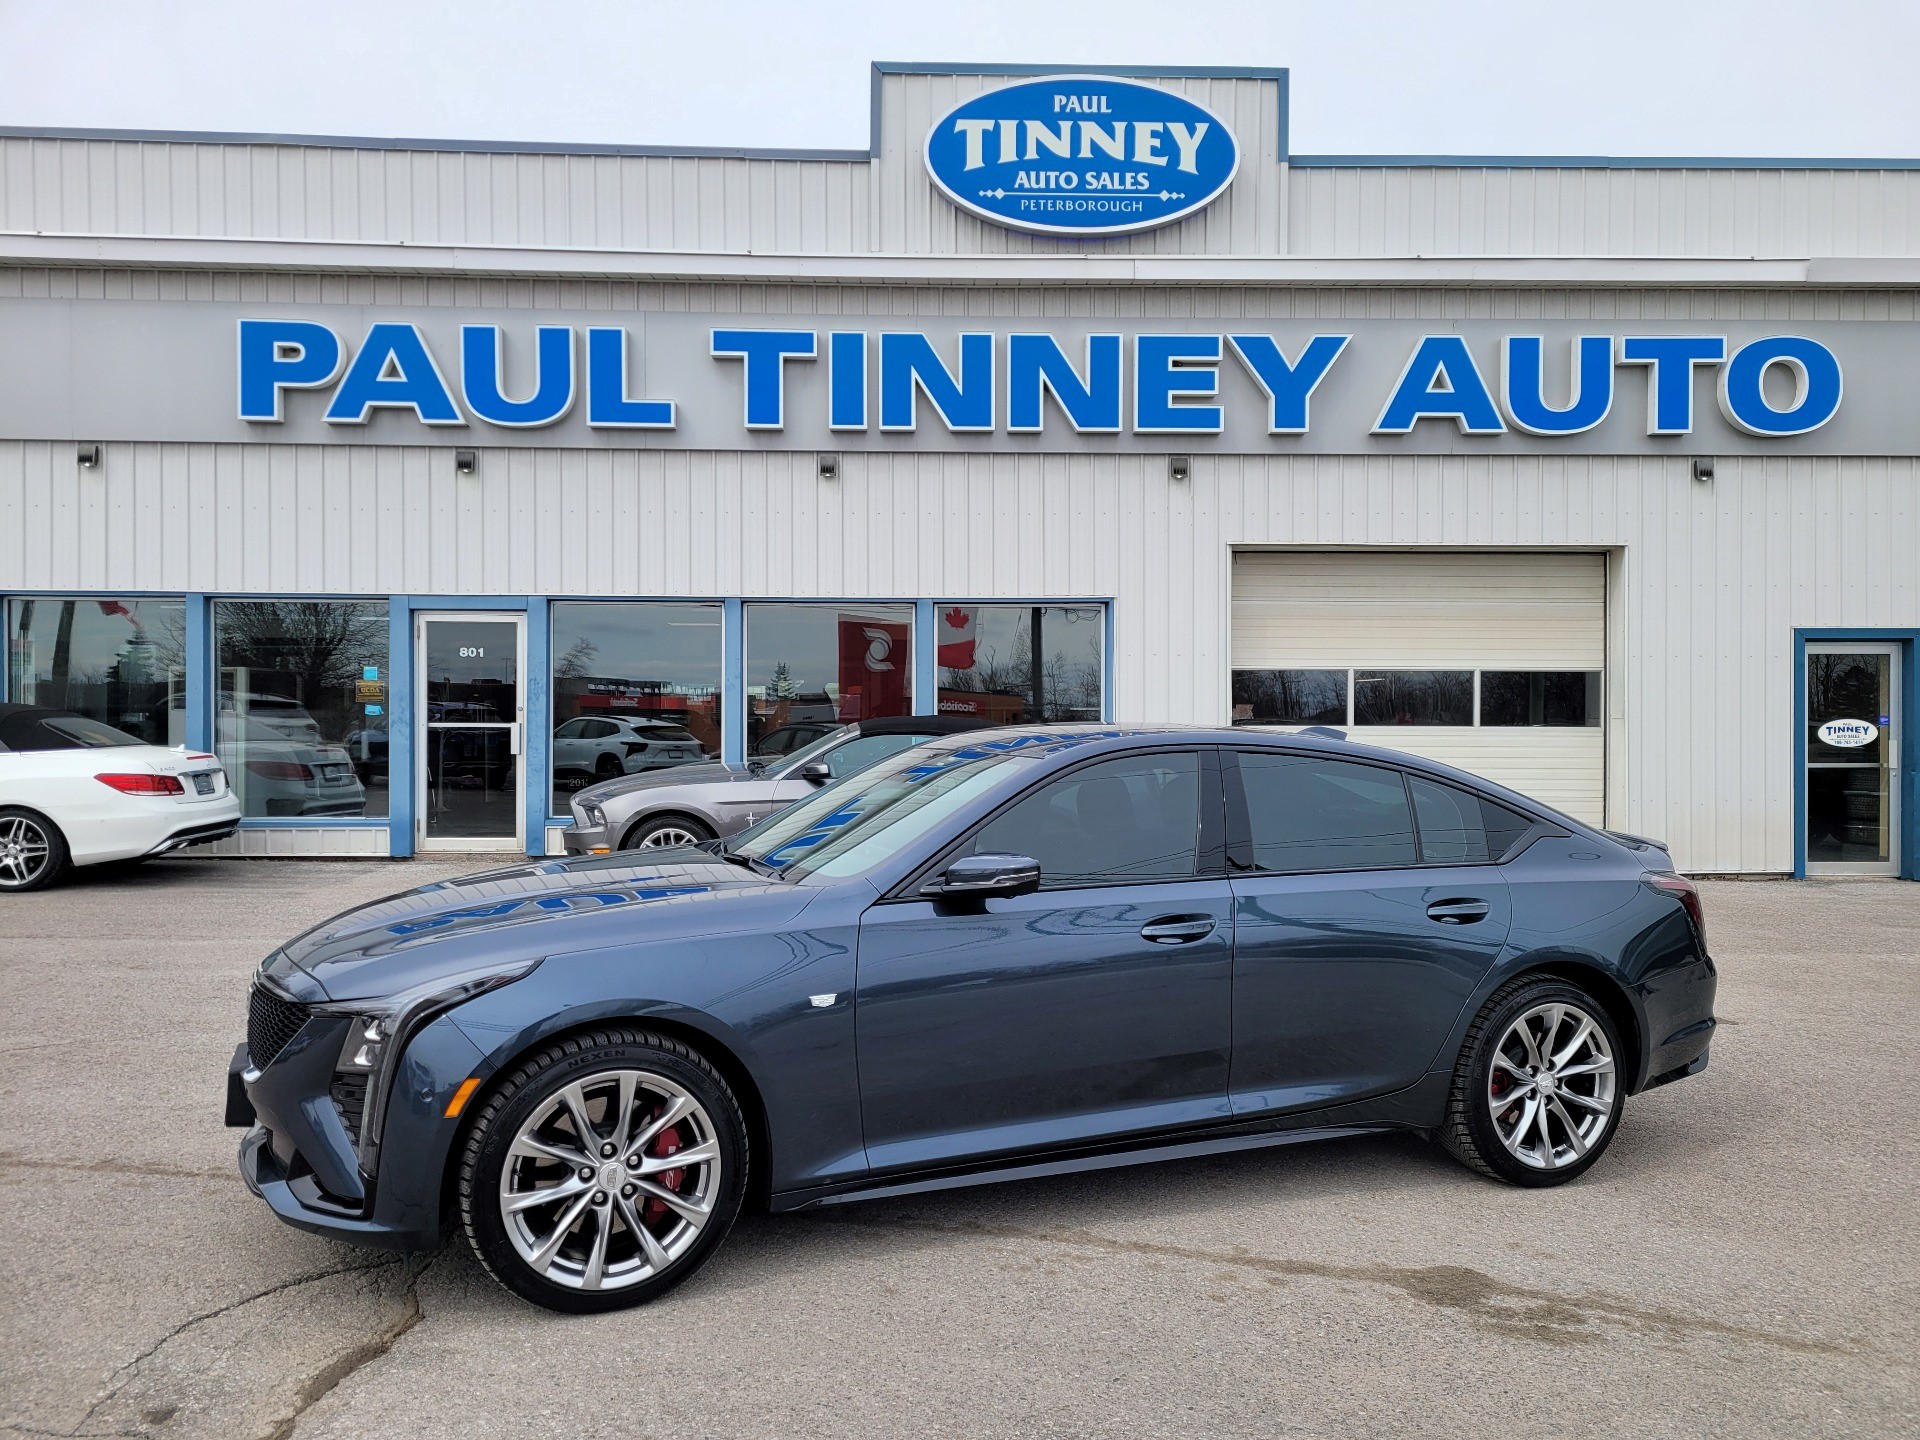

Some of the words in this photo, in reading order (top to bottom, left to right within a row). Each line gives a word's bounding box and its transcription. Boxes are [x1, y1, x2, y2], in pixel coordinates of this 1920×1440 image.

[1053, 94, 1112, 113] PAUL
[954, 118, 1210, 175] TINNEY
[1014, 171, 1079, 189] AUTO
[1085, 171, 1150, 190] SALES
[1020, 199, 1143, 212] PETERBOROUGH
[236, 317, 676, 430] PAUL
[709, 327, 1354, 436] TINNEY
[1368, 333, 1844, 438] AUTO
[459, 647, 485, 658] 801
[1826, 726, 1870, 736] TINNEY
[567, 1049, 627, 1069] NEXEN
